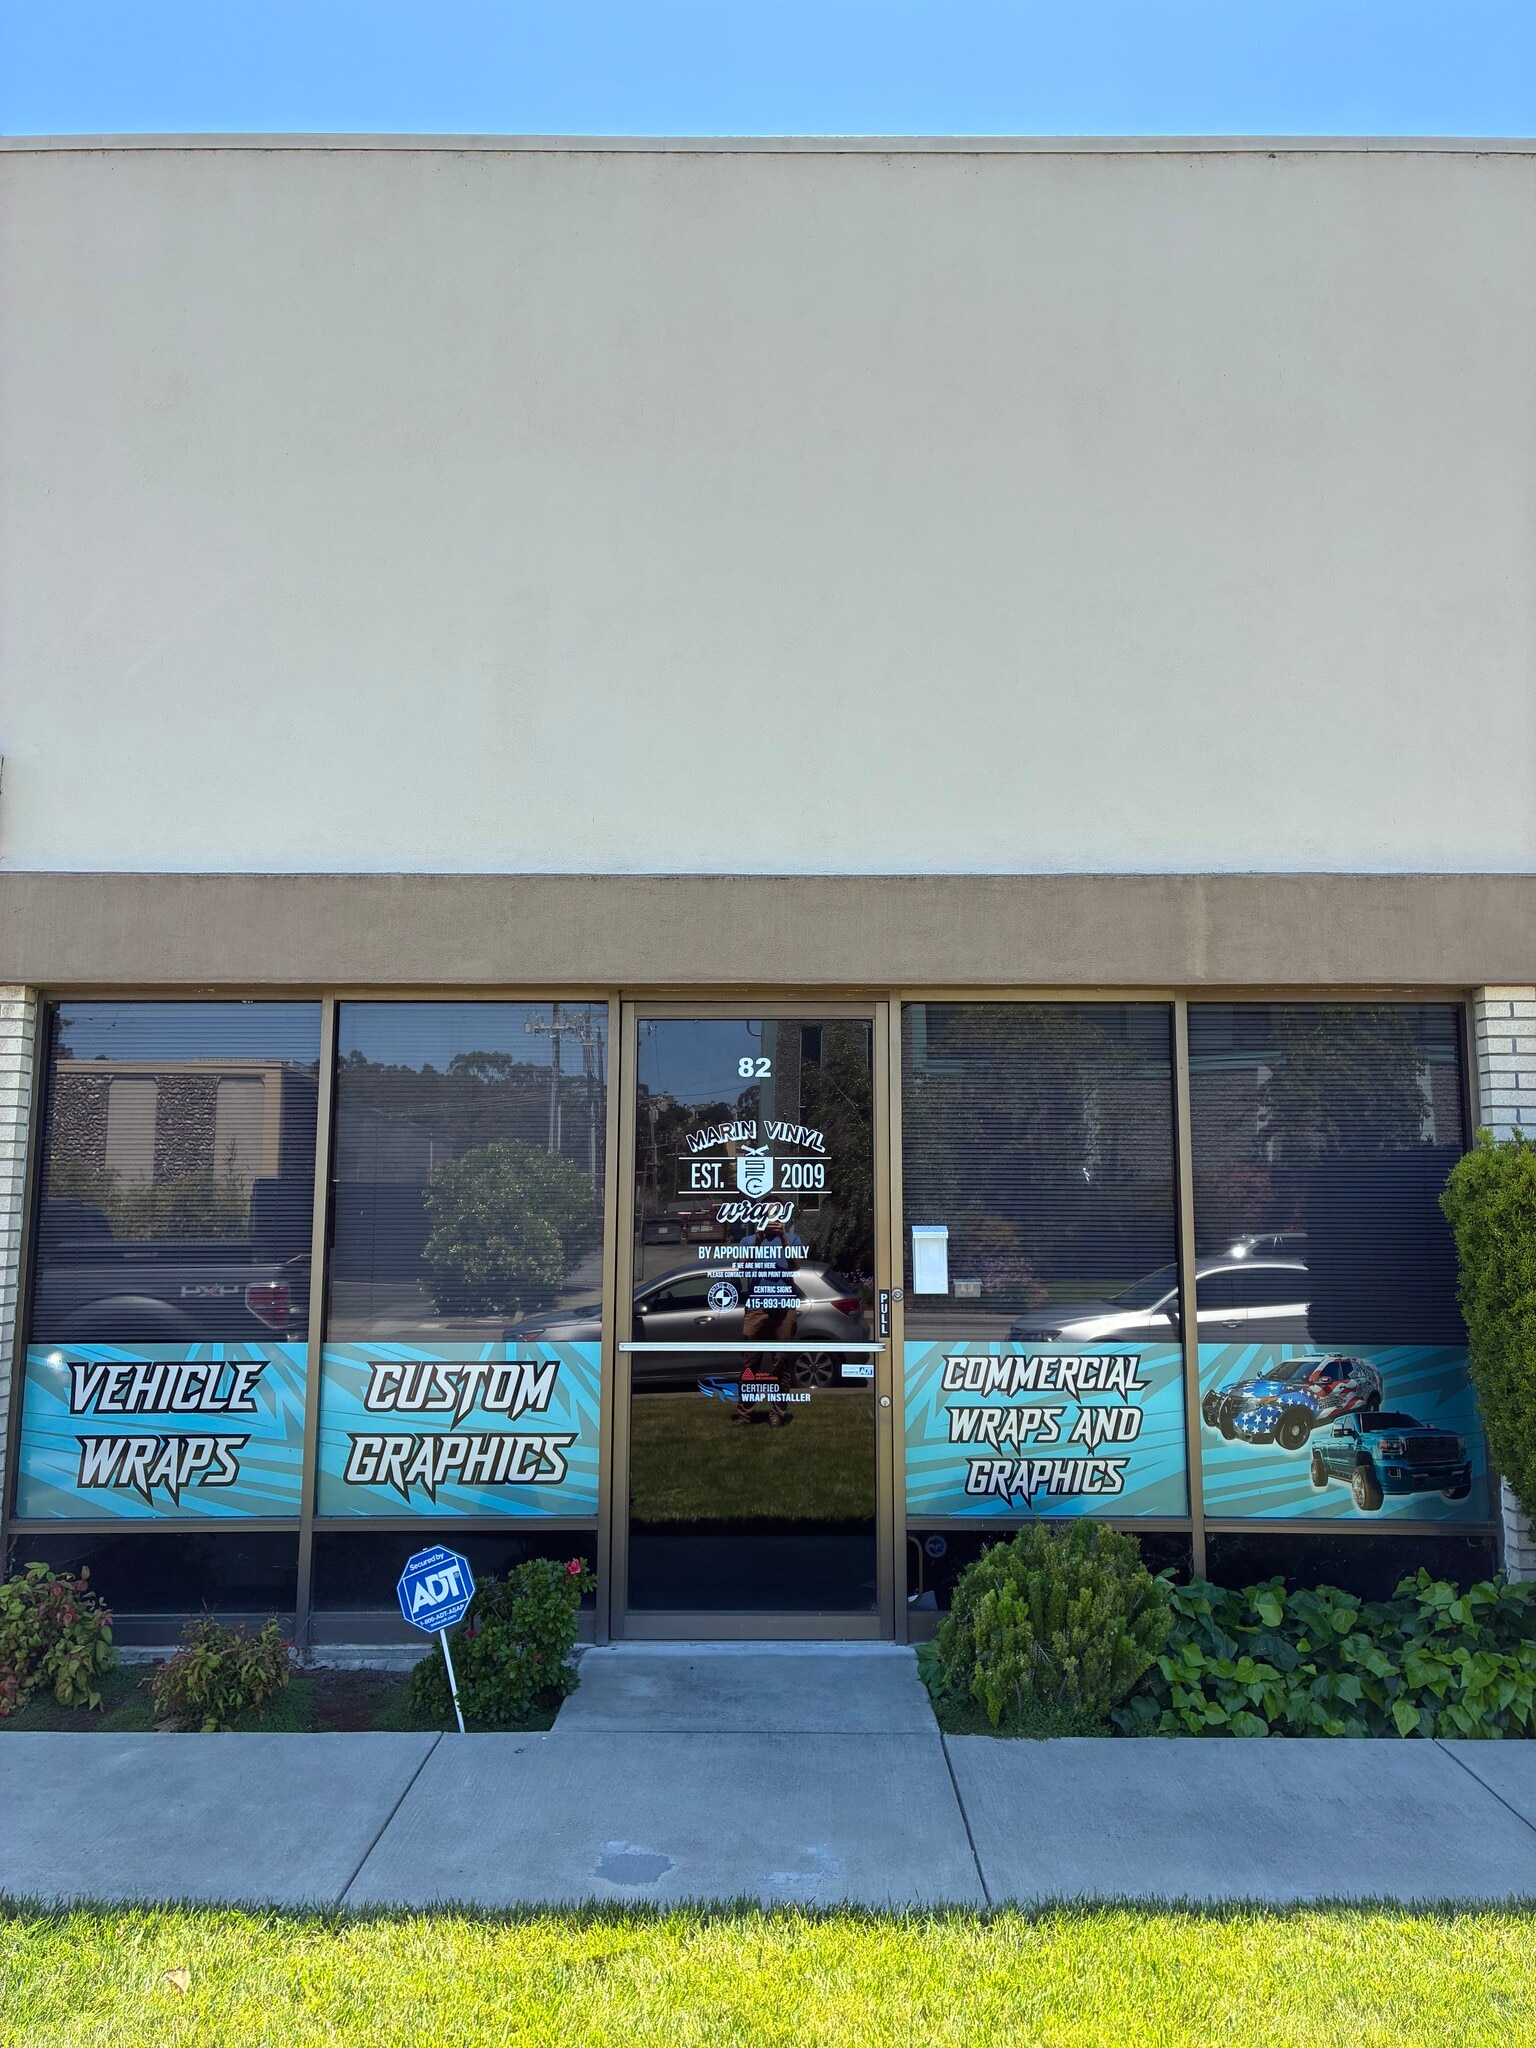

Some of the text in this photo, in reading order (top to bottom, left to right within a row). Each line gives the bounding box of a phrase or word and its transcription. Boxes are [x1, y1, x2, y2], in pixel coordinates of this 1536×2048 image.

[738, 1057, 771, 1078] 82
[686, 1120, 826, 1153] MARIN VINYL
[691, 1163, 825, 1189] EST. 2009
[716, 1200, 795, 1231] wraps
[698, 1246, 810, 1259] BY APPOINTMENT ONLY
[745, 1298, 801, 1309] 415-893-0400
[880, 1293, 888, 1334] PULL
[67, 1361, 270, 1414] VEHICLE
[741, 1384, 780, 1392] CERTIFIED
[941, 1355, 1152, 1404] COMMERCIAL
[364, 1361, 560, 1432] CUSTOM
[742, 1393, 811, 1402] WRAP INSTALLER
[945, 1406, 1143, 1457] WRAPS AND
[75, 1434, 252, 1507] WRAPS
[343, 1433, 579, 1505] GRAPHICS
[965, 1458, 1130, 1510] GRAPHICS
[409, 1554, 437, 1571] Secured
[412, 1565, 460, 1614] ADT
[420, 1604, 464, 1626] 1-800-ADT-ASAP
